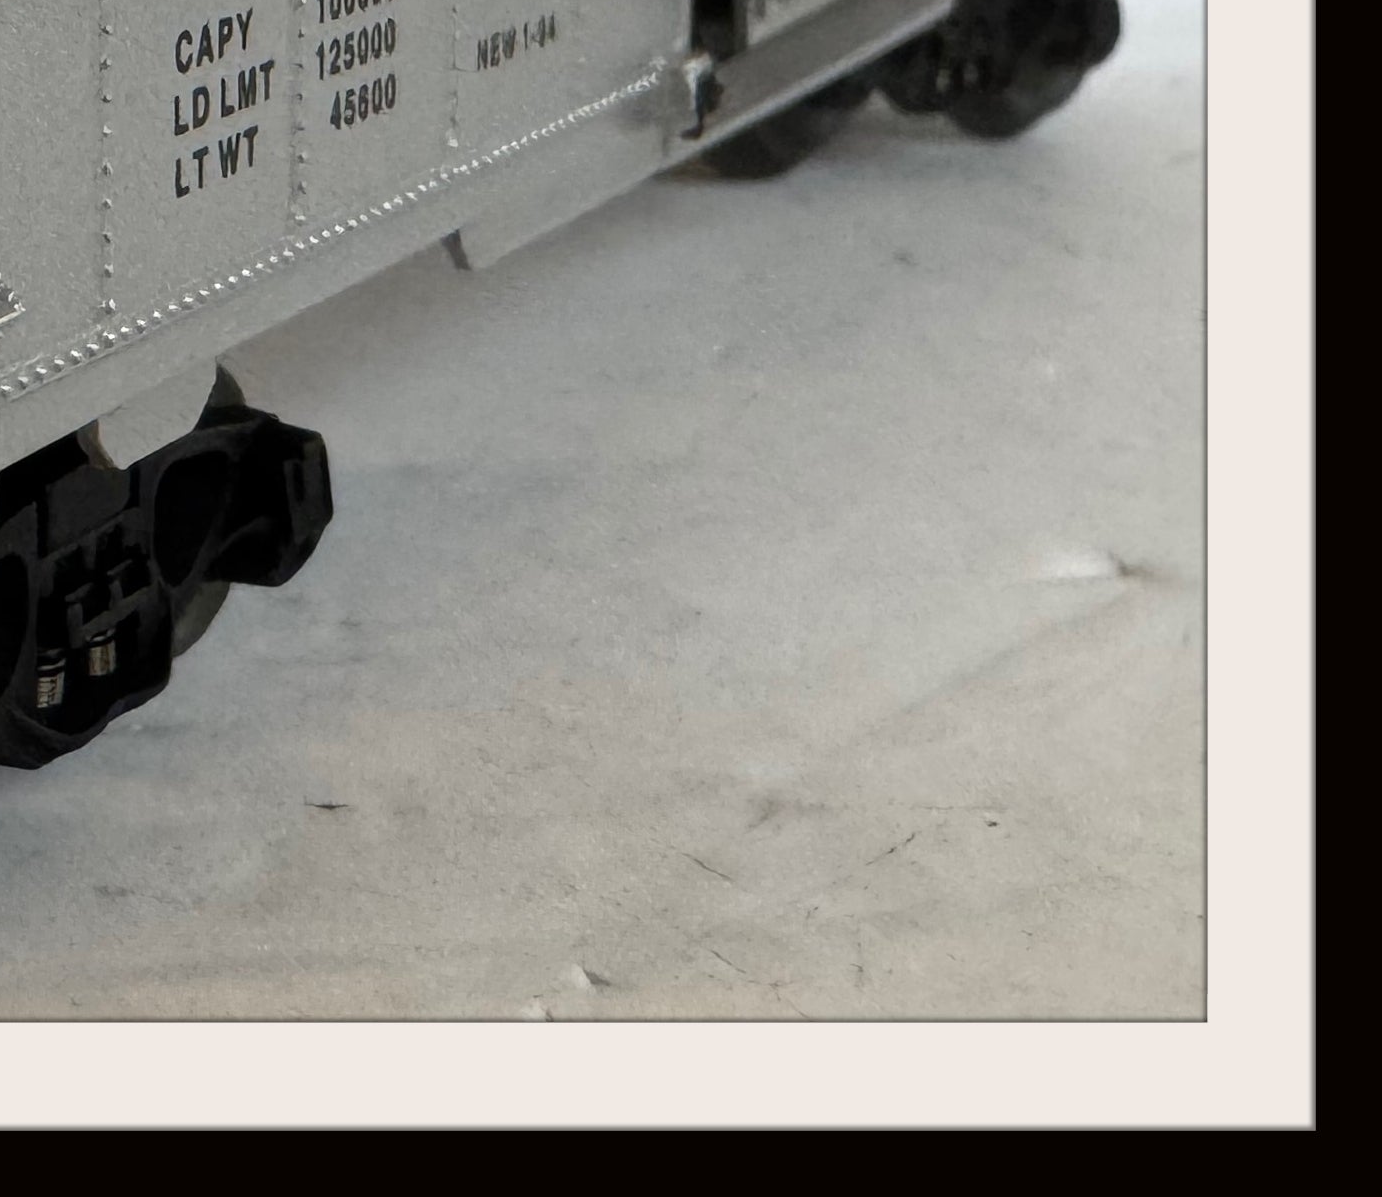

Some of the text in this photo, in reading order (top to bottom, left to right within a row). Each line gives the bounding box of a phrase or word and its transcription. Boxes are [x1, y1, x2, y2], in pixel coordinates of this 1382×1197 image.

[175, 9, 252, 73] CAPY
[476, 25, 517, 71] NEW
[174, 18, 397, 136] LD LMT 125000
[175, 146, 209, 198] LT
[218, 126, 259, 178] WT
